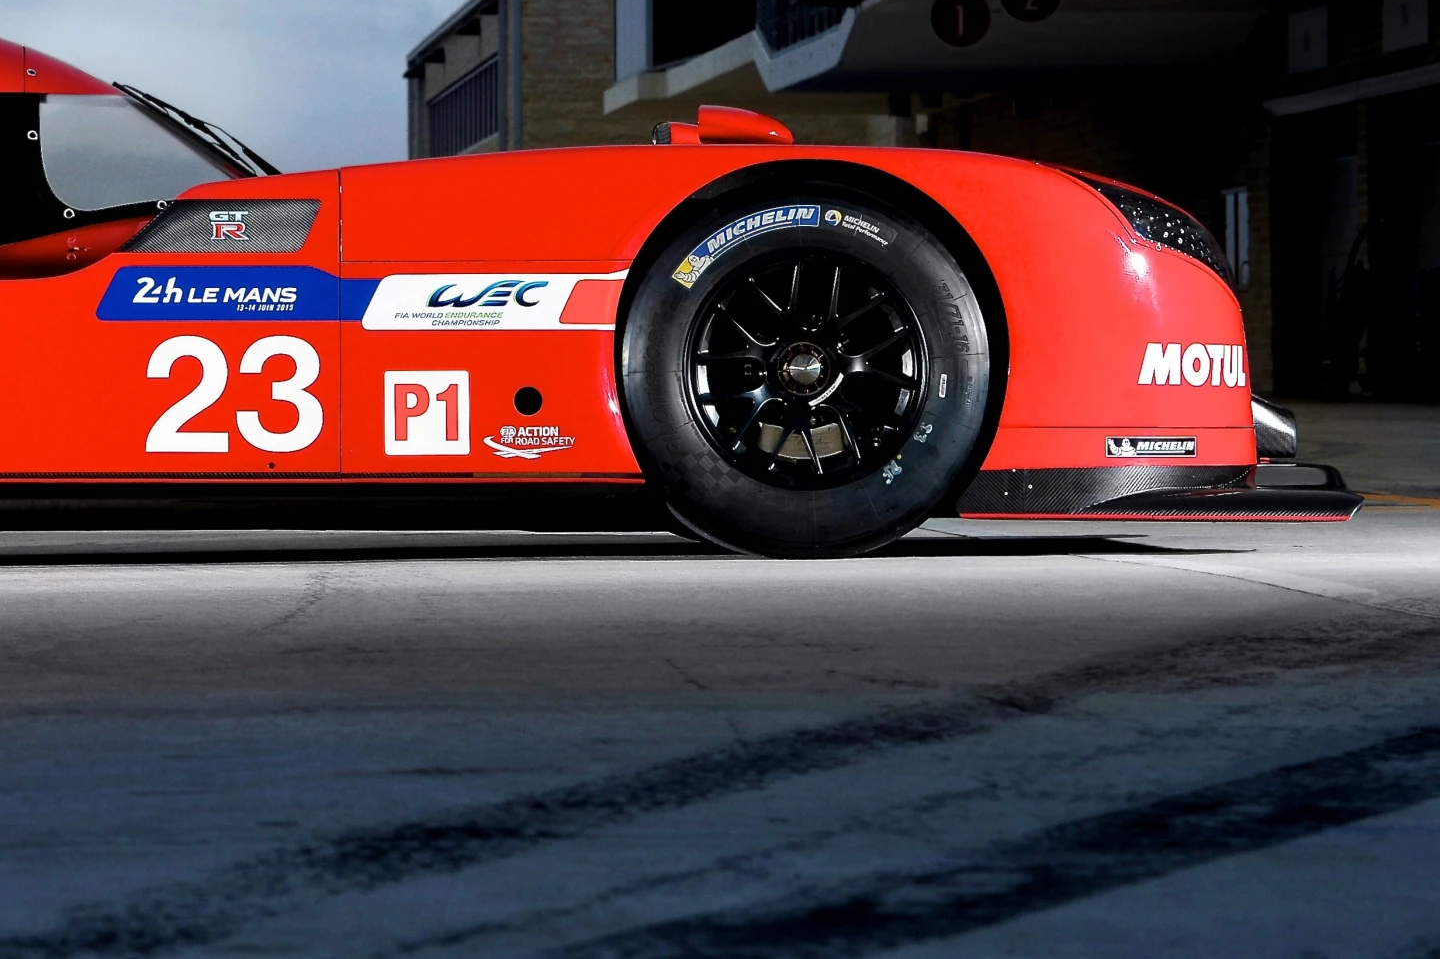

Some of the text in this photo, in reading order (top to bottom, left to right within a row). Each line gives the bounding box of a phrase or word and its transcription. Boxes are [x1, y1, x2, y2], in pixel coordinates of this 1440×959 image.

[956, 5, 964, 36] 1
[209, 210, 249, 221] GT
[707, 207, 816, 254] MICHELIN
[844, 214, 880, 234] MICHELIN
[187, 287, 220, 303] LE
[222, 287, 298, 303] MANS
[426, 279, 549, 308] WEC
[276, 303, 295, 312] 2015
[444, 311, 504, 319] ENDURANCE
[431, 319, 501, 327] CHAMPIONSHIP
[1137, 342, 1246, 387] MOTUL
[145, 335, 324, 453] 23
[393, 383, 460, 442] P1
[517, 426, 559, 437] ACTION
[515, 437, 540, 446] ROAD
[541, 437, 576, 446] SAFETY
[1136, 441, 1195, 451] MICHELIN
